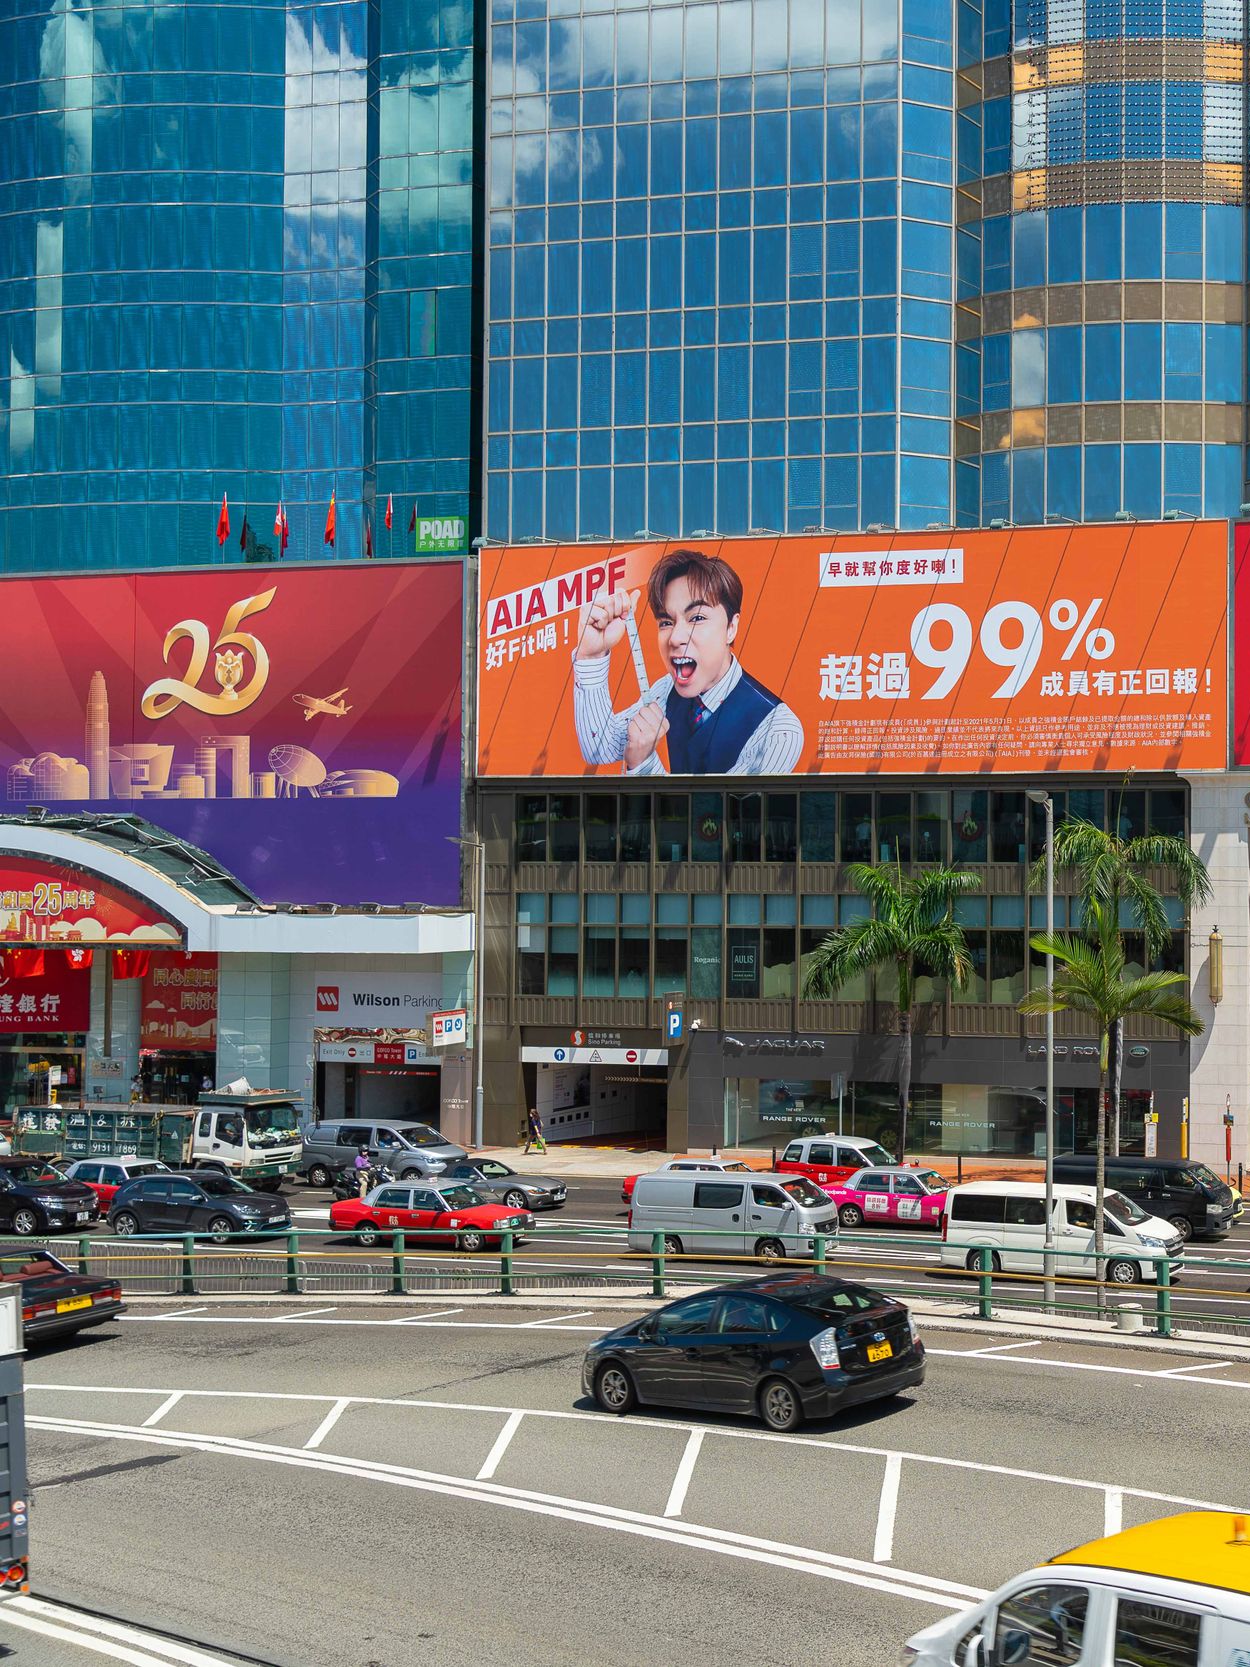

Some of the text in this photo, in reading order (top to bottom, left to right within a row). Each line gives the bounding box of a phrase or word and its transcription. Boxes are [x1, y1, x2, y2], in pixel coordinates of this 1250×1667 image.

[420, 519, 465, 540] POAD
[489, 557, 627, 636] AIA MPF
[141, 585, 278, 719] 25
[819, 652, 911, 702] 超過
[909, 598, 1116, 701] 99%
[0, 882, 95, 916] 祖國25周年
[734, 954, 754, 964] AULIS
[153, 968, 218, 987] 同心慶回
[353, 993, 443, 1010] Wilson Parking
[670, 1014, 680, 1036] P
[334, 1048, 346, 1056] Only
[749, 1039, 825, 1049] JAGUAR
[1073, 1046, 1101, 1055] ROV
[963, 1121, 996, 1129] ROVER
